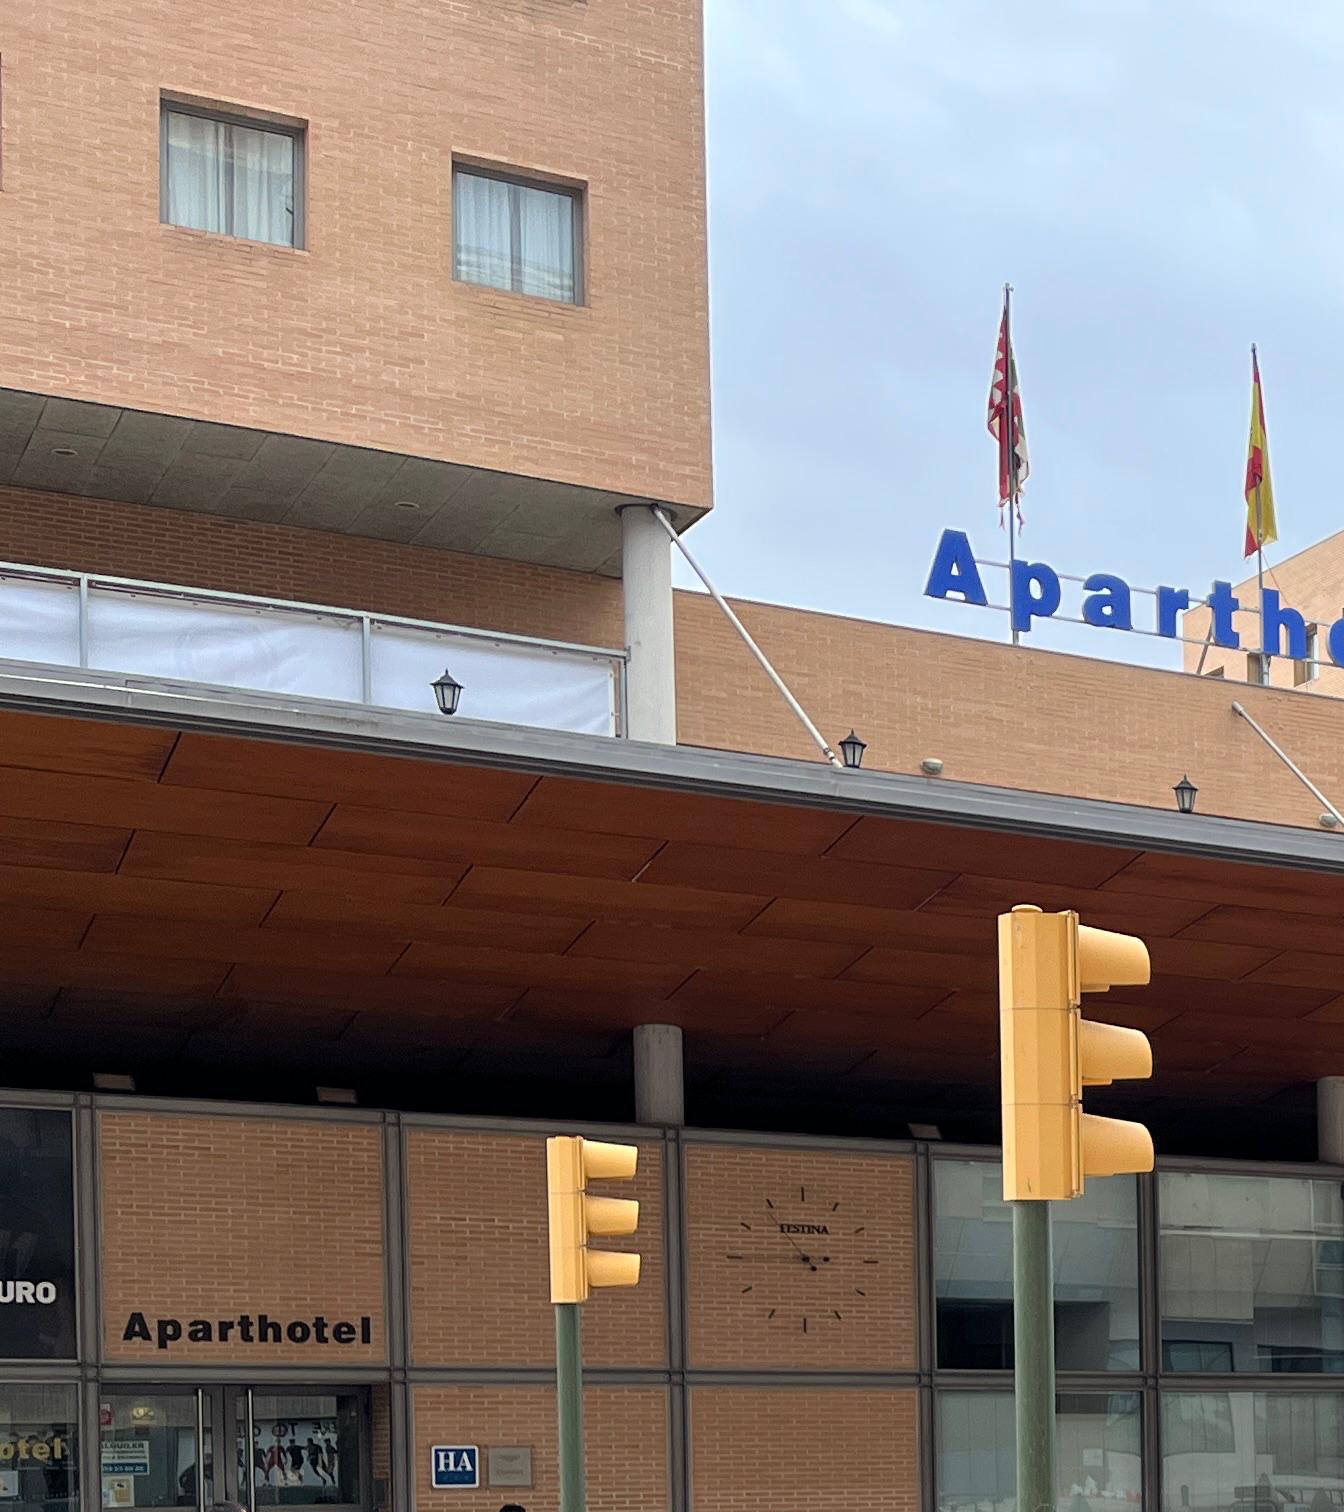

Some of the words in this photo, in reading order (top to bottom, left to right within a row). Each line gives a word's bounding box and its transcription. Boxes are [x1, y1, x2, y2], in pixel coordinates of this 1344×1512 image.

[780, 1224, 829, 1235] FESTINA
[0, 1280, 57, 1305] URO
[122, 1311, 372, 1349] Aparthotel
[437, 1450, 474, 1472] HA
